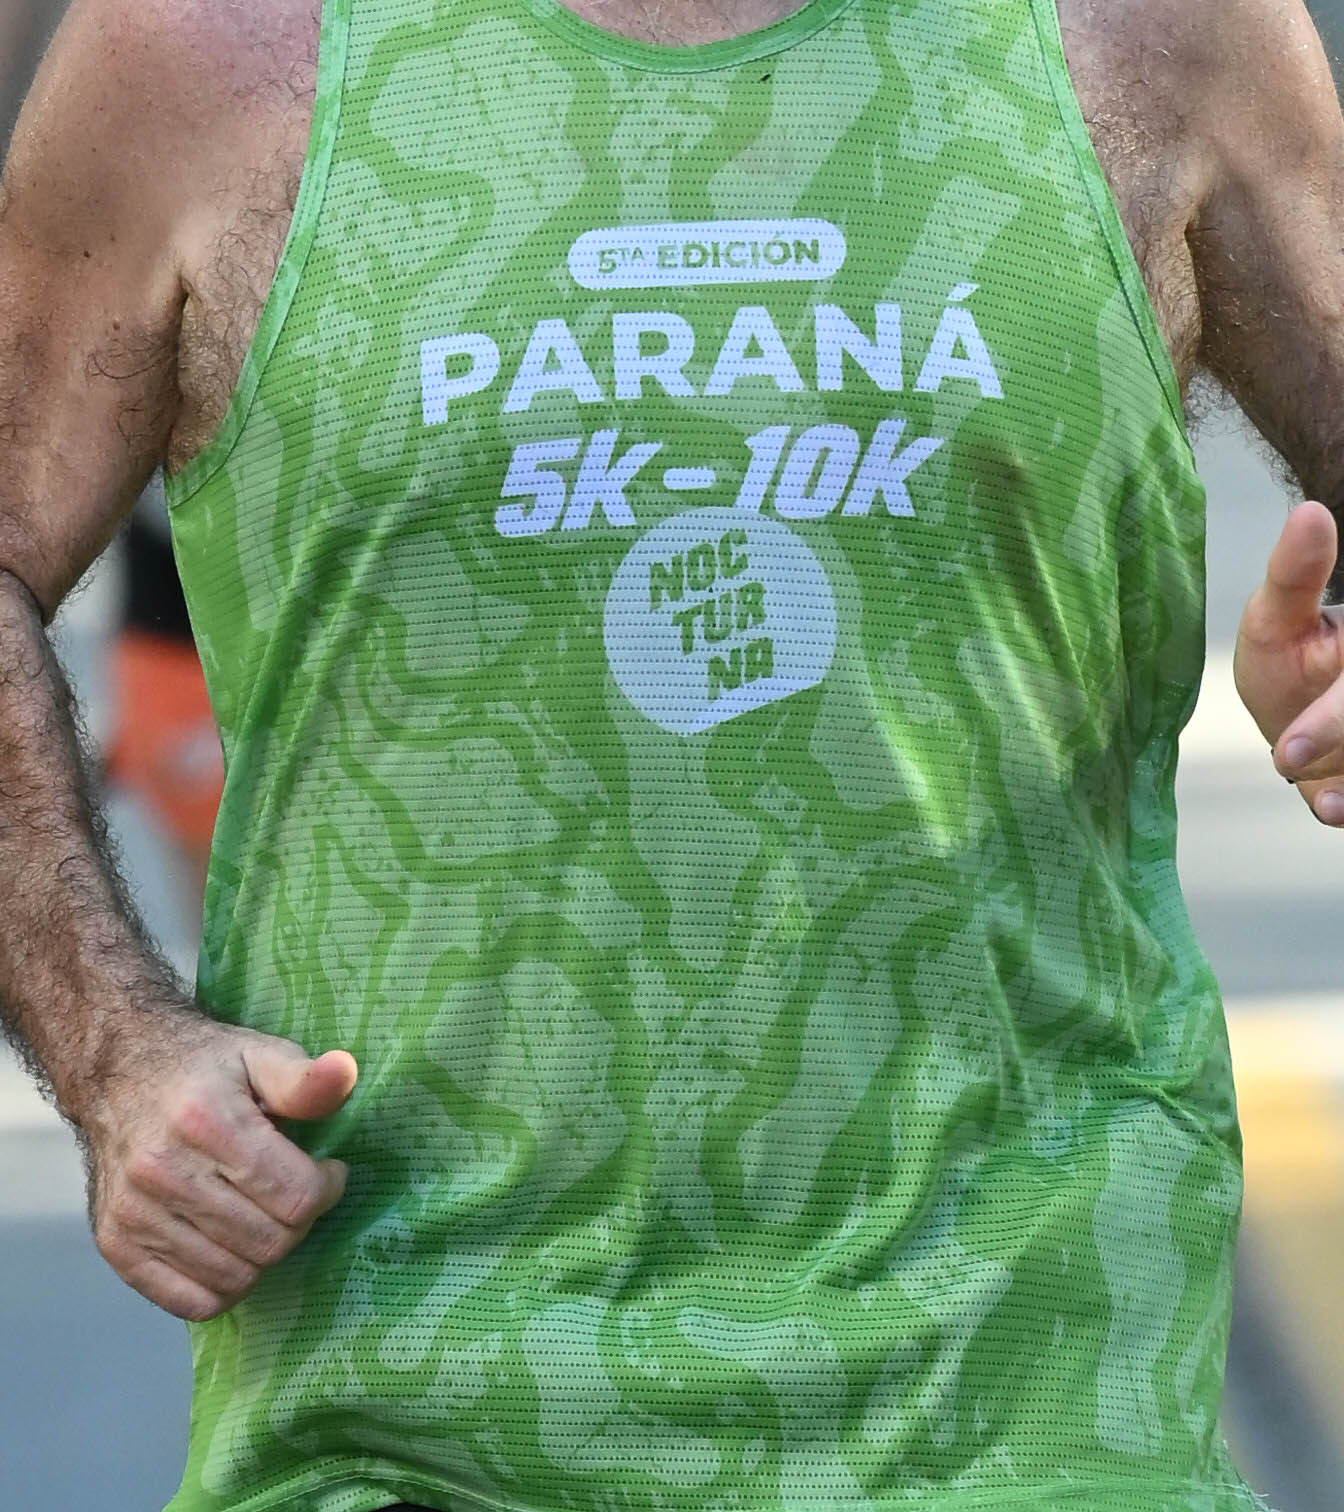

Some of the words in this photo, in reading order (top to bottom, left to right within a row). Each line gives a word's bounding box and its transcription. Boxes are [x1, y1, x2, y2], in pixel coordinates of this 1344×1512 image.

[656, 231, 820, 270] EDICIÓN
[419, 283, 1005, 425] PARANÁ
[649, 528, 748, 609] NOC
[672, 582, 765, 655] TUR
[707, 637, 773, 701] NA
